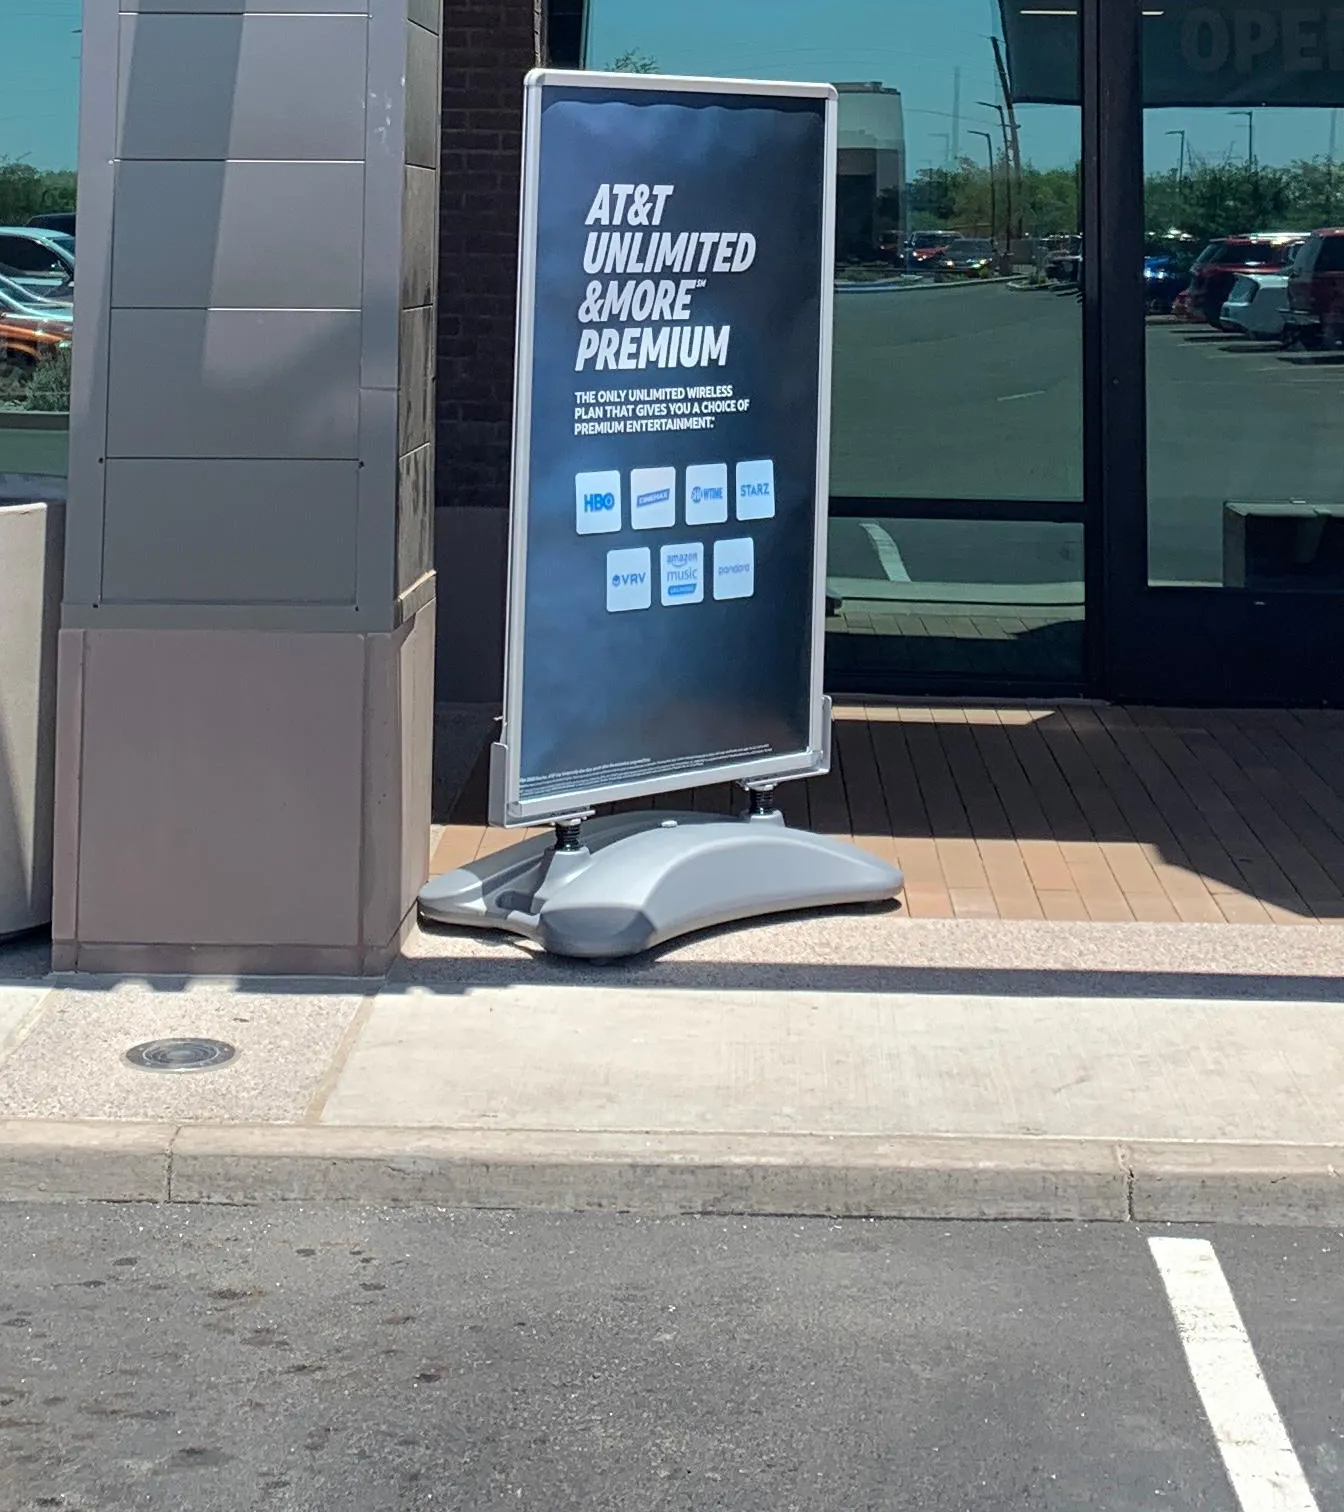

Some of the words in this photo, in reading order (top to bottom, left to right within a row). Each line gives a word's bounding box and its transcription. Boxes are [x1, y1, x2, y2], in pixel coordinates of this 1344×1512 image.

[585, 183, 674, 226] AT&T
[583, 232, 757, 274] UNLIMITED
[578, 279, 697, 323] &MORE
[575, 325, 731, 371] PREMIUM
[574, 391, 596, 404] THE
[598, 390, 628, 403] ONLY
[628, 387, 685, 402] UNLIMITED
[687, 385, 734, 399] WIRELESS
[574, 406, 604, 420] PLAN
[605, 404, 633, 418] THAT
[636, 403, 667, 417] GIVES
[668, 401, 691, 415] YOU
[692, 401, 701, 414] A
[701, 399, 737, 413] CHOICE
[737, 398, 751, 412] OF
[574, 421, 625, 435] PREMIUM
[740, 483, 770, 496] STARZ
[583, 492, 616, 512] HBO
[666, 552, 698, 564] amazon
[620, 572, 647, 585] VRV
[666, 567, 698, 582] music
[718, 563, 750, 576] pandora
